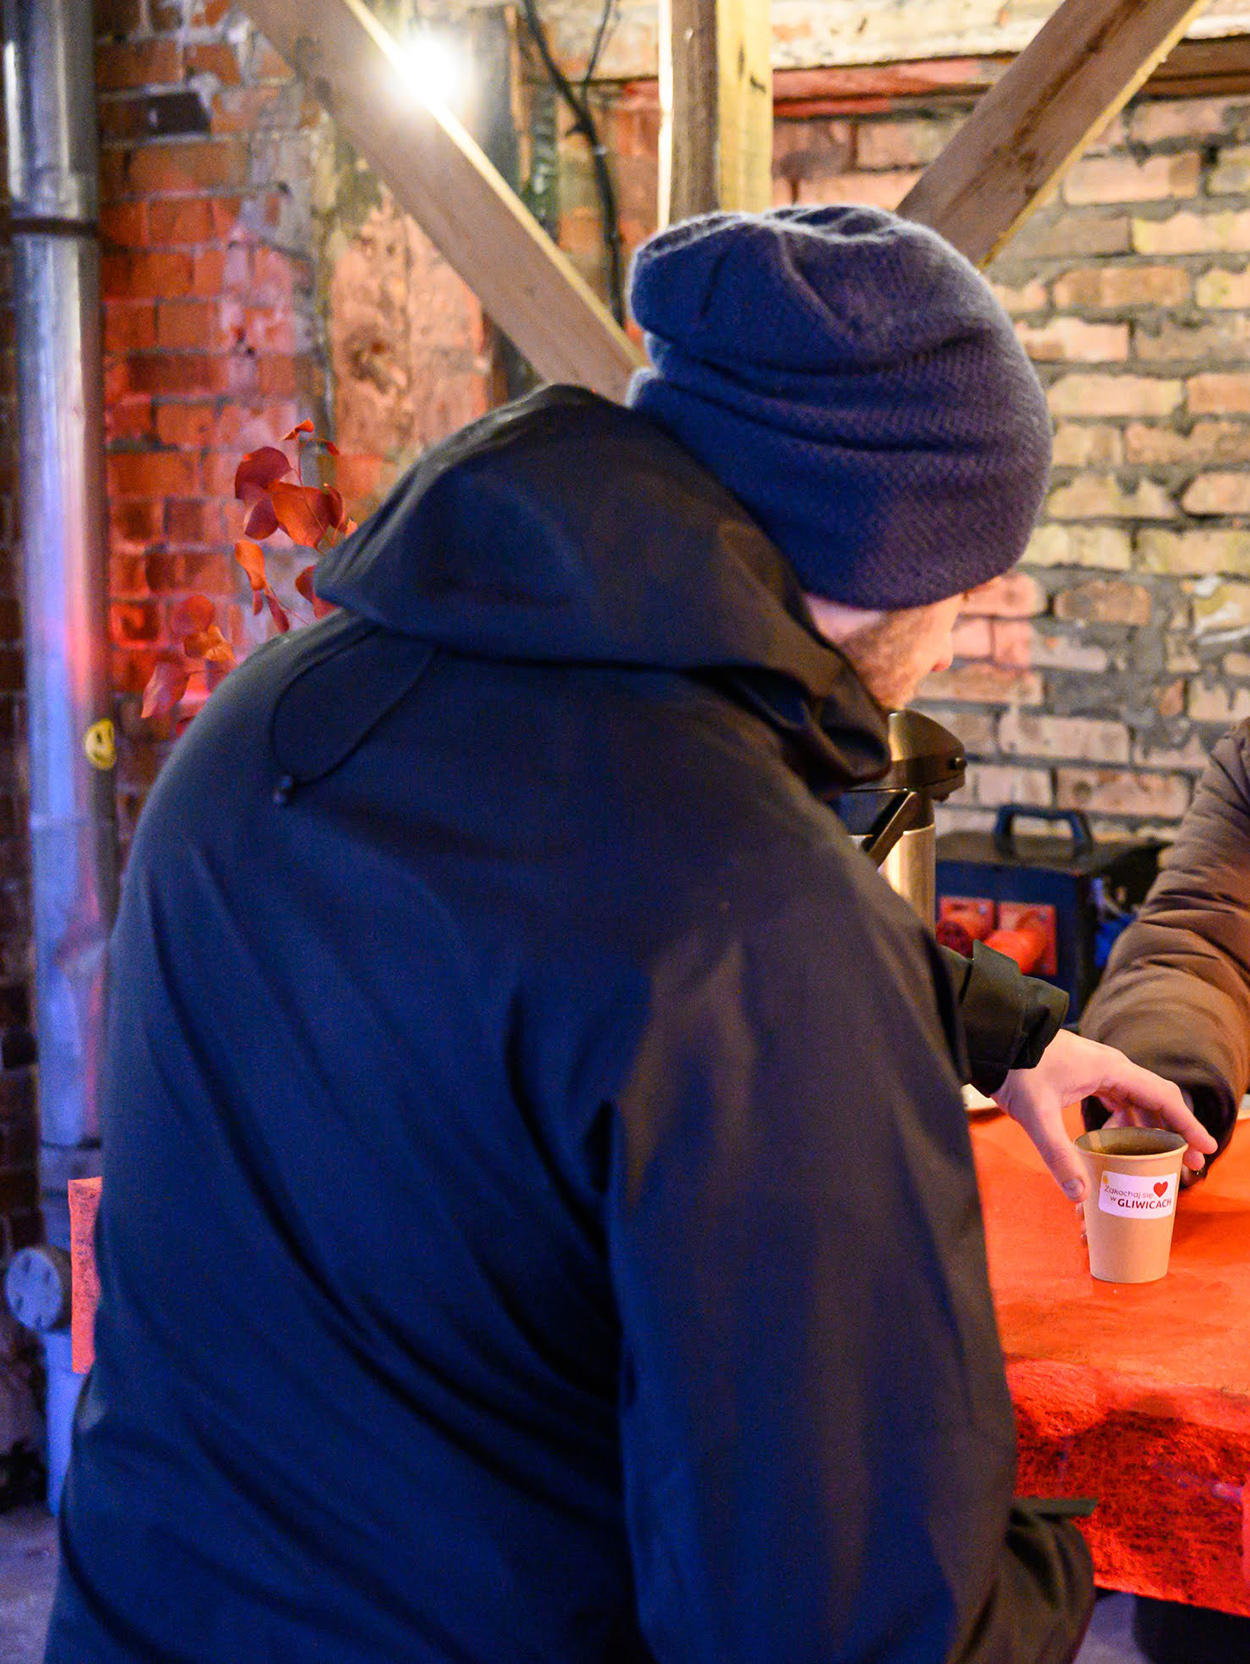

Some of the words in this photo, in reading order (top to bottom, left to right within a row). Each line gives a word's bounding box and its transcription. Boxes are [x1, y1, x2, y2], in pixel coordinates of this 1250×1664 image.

[1103, 1185, 1140, 1199] Zakochaj
[1142, 1191, 1154, 1200] się
[1117, 1198, 1172, 1209] GLIWICACH
